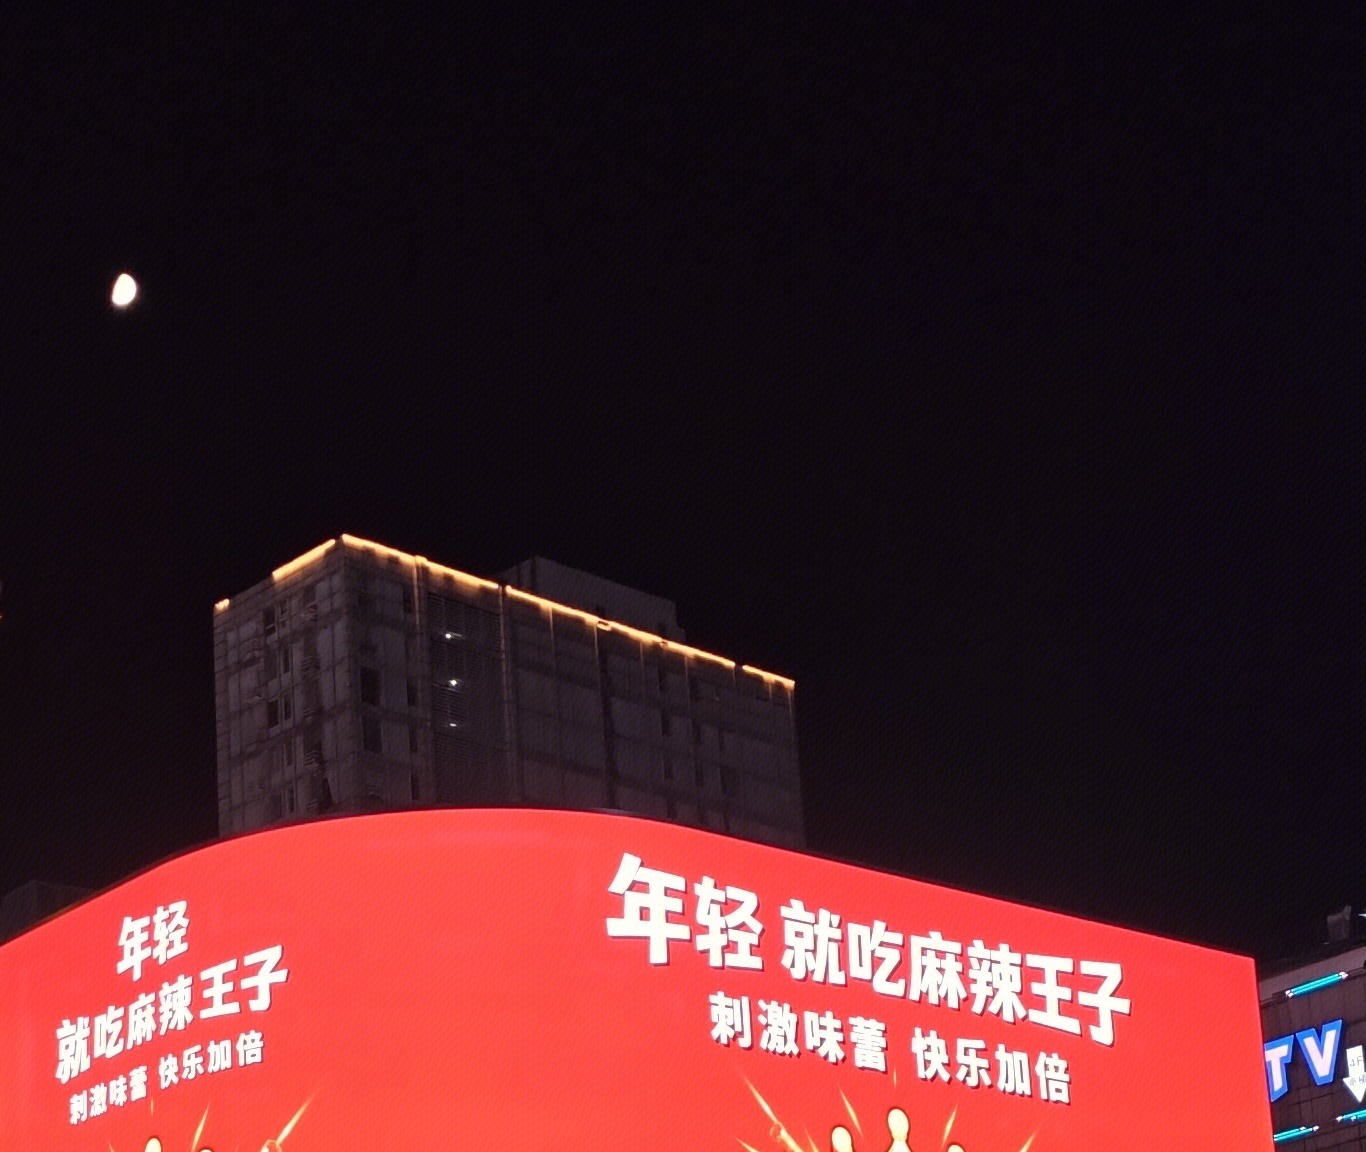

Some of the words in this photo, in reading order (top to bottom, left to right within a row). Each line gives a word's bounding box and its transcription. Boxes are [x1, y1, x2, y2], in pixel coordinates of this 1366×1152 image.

[115, 900, 191, 981] 年轻
[607, 853, 763, 970] 年轻
[781, 899, 1131, 1047] 就吃麻辣王子
[55, 945, 289, 1085] 就吃麻辣王子
[710, 992, 889, 1074] 刺激味蕾
[911, 1027, 1072, 1106] 快乐加倍
[69, 1066, 149, 1125] 刺激味蕾
[158, 1029, 265, 1090] 快乐加倍
